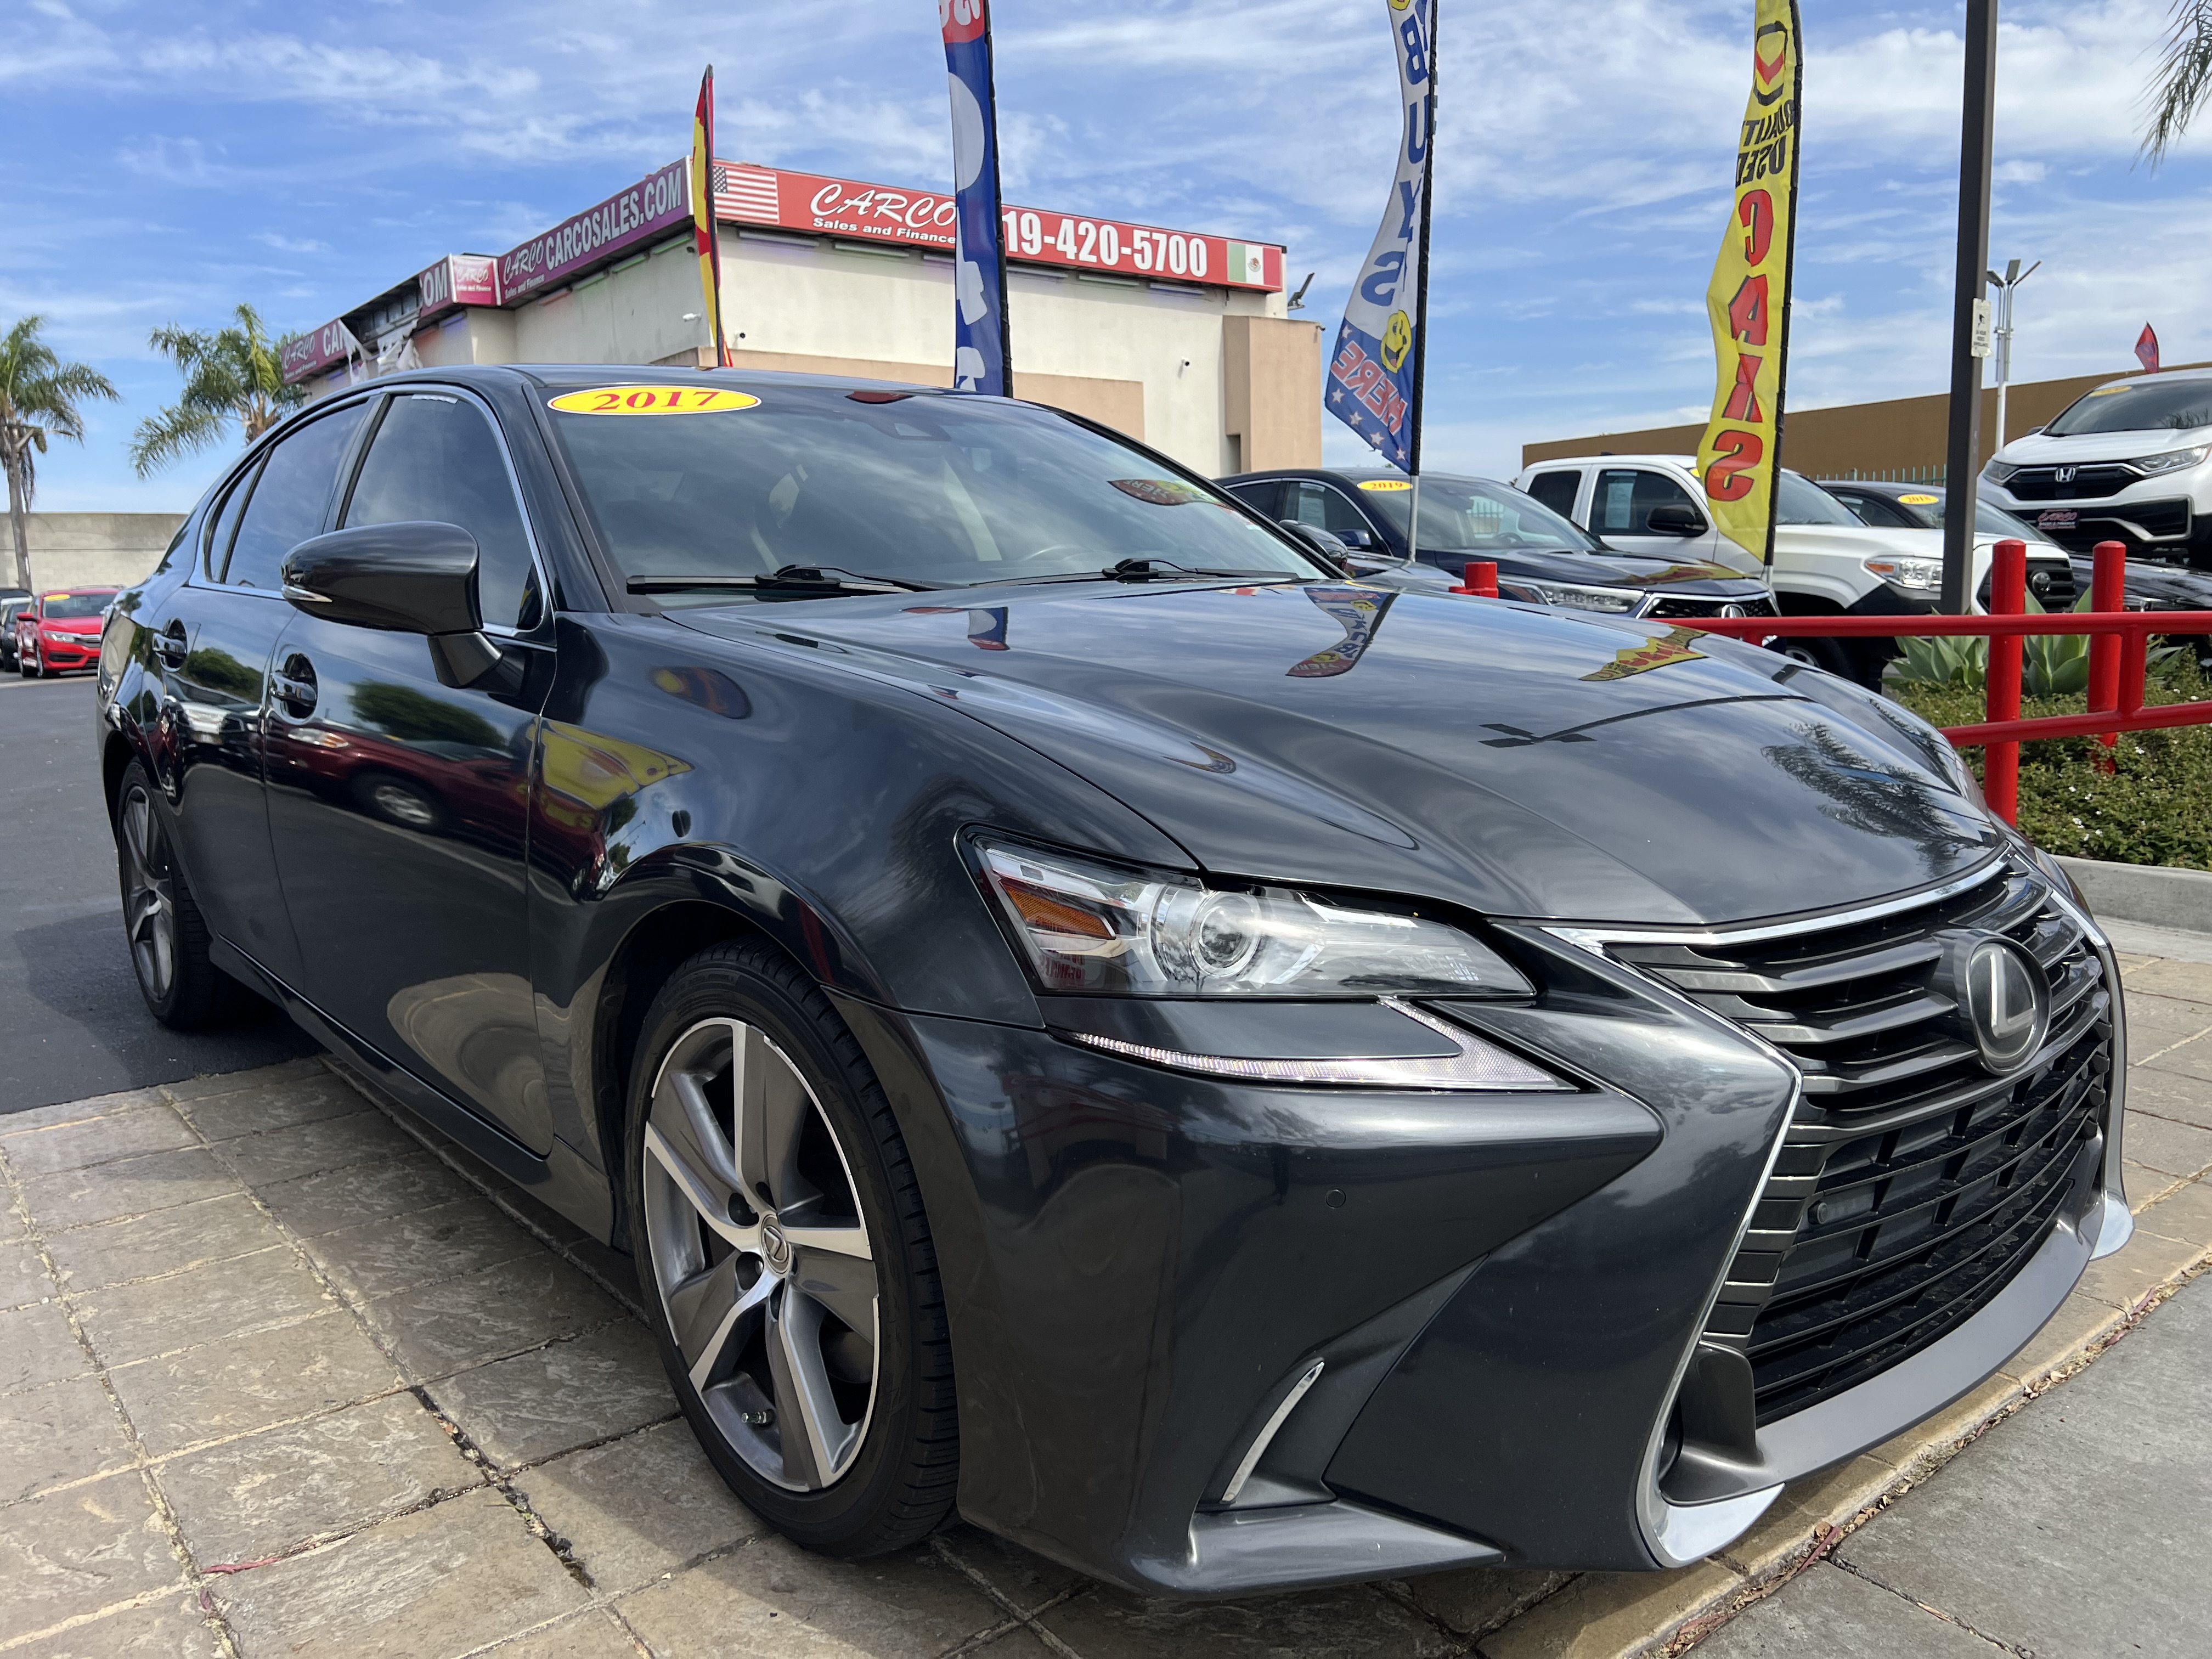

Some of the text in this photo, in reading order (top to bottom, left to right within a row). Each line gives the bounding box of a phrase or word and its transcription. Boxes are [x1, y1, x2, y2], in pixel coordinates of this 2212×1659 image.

[504, 167, 682, 285] CARCO CARCOSALES.COM
[810, 183, 1207, 278] CARCO 19-420-5700
[812, 218, 956, 244] Sales and Finance
[420, 262, 448, 308] OM
[591, 391, 720, 411] 2017
